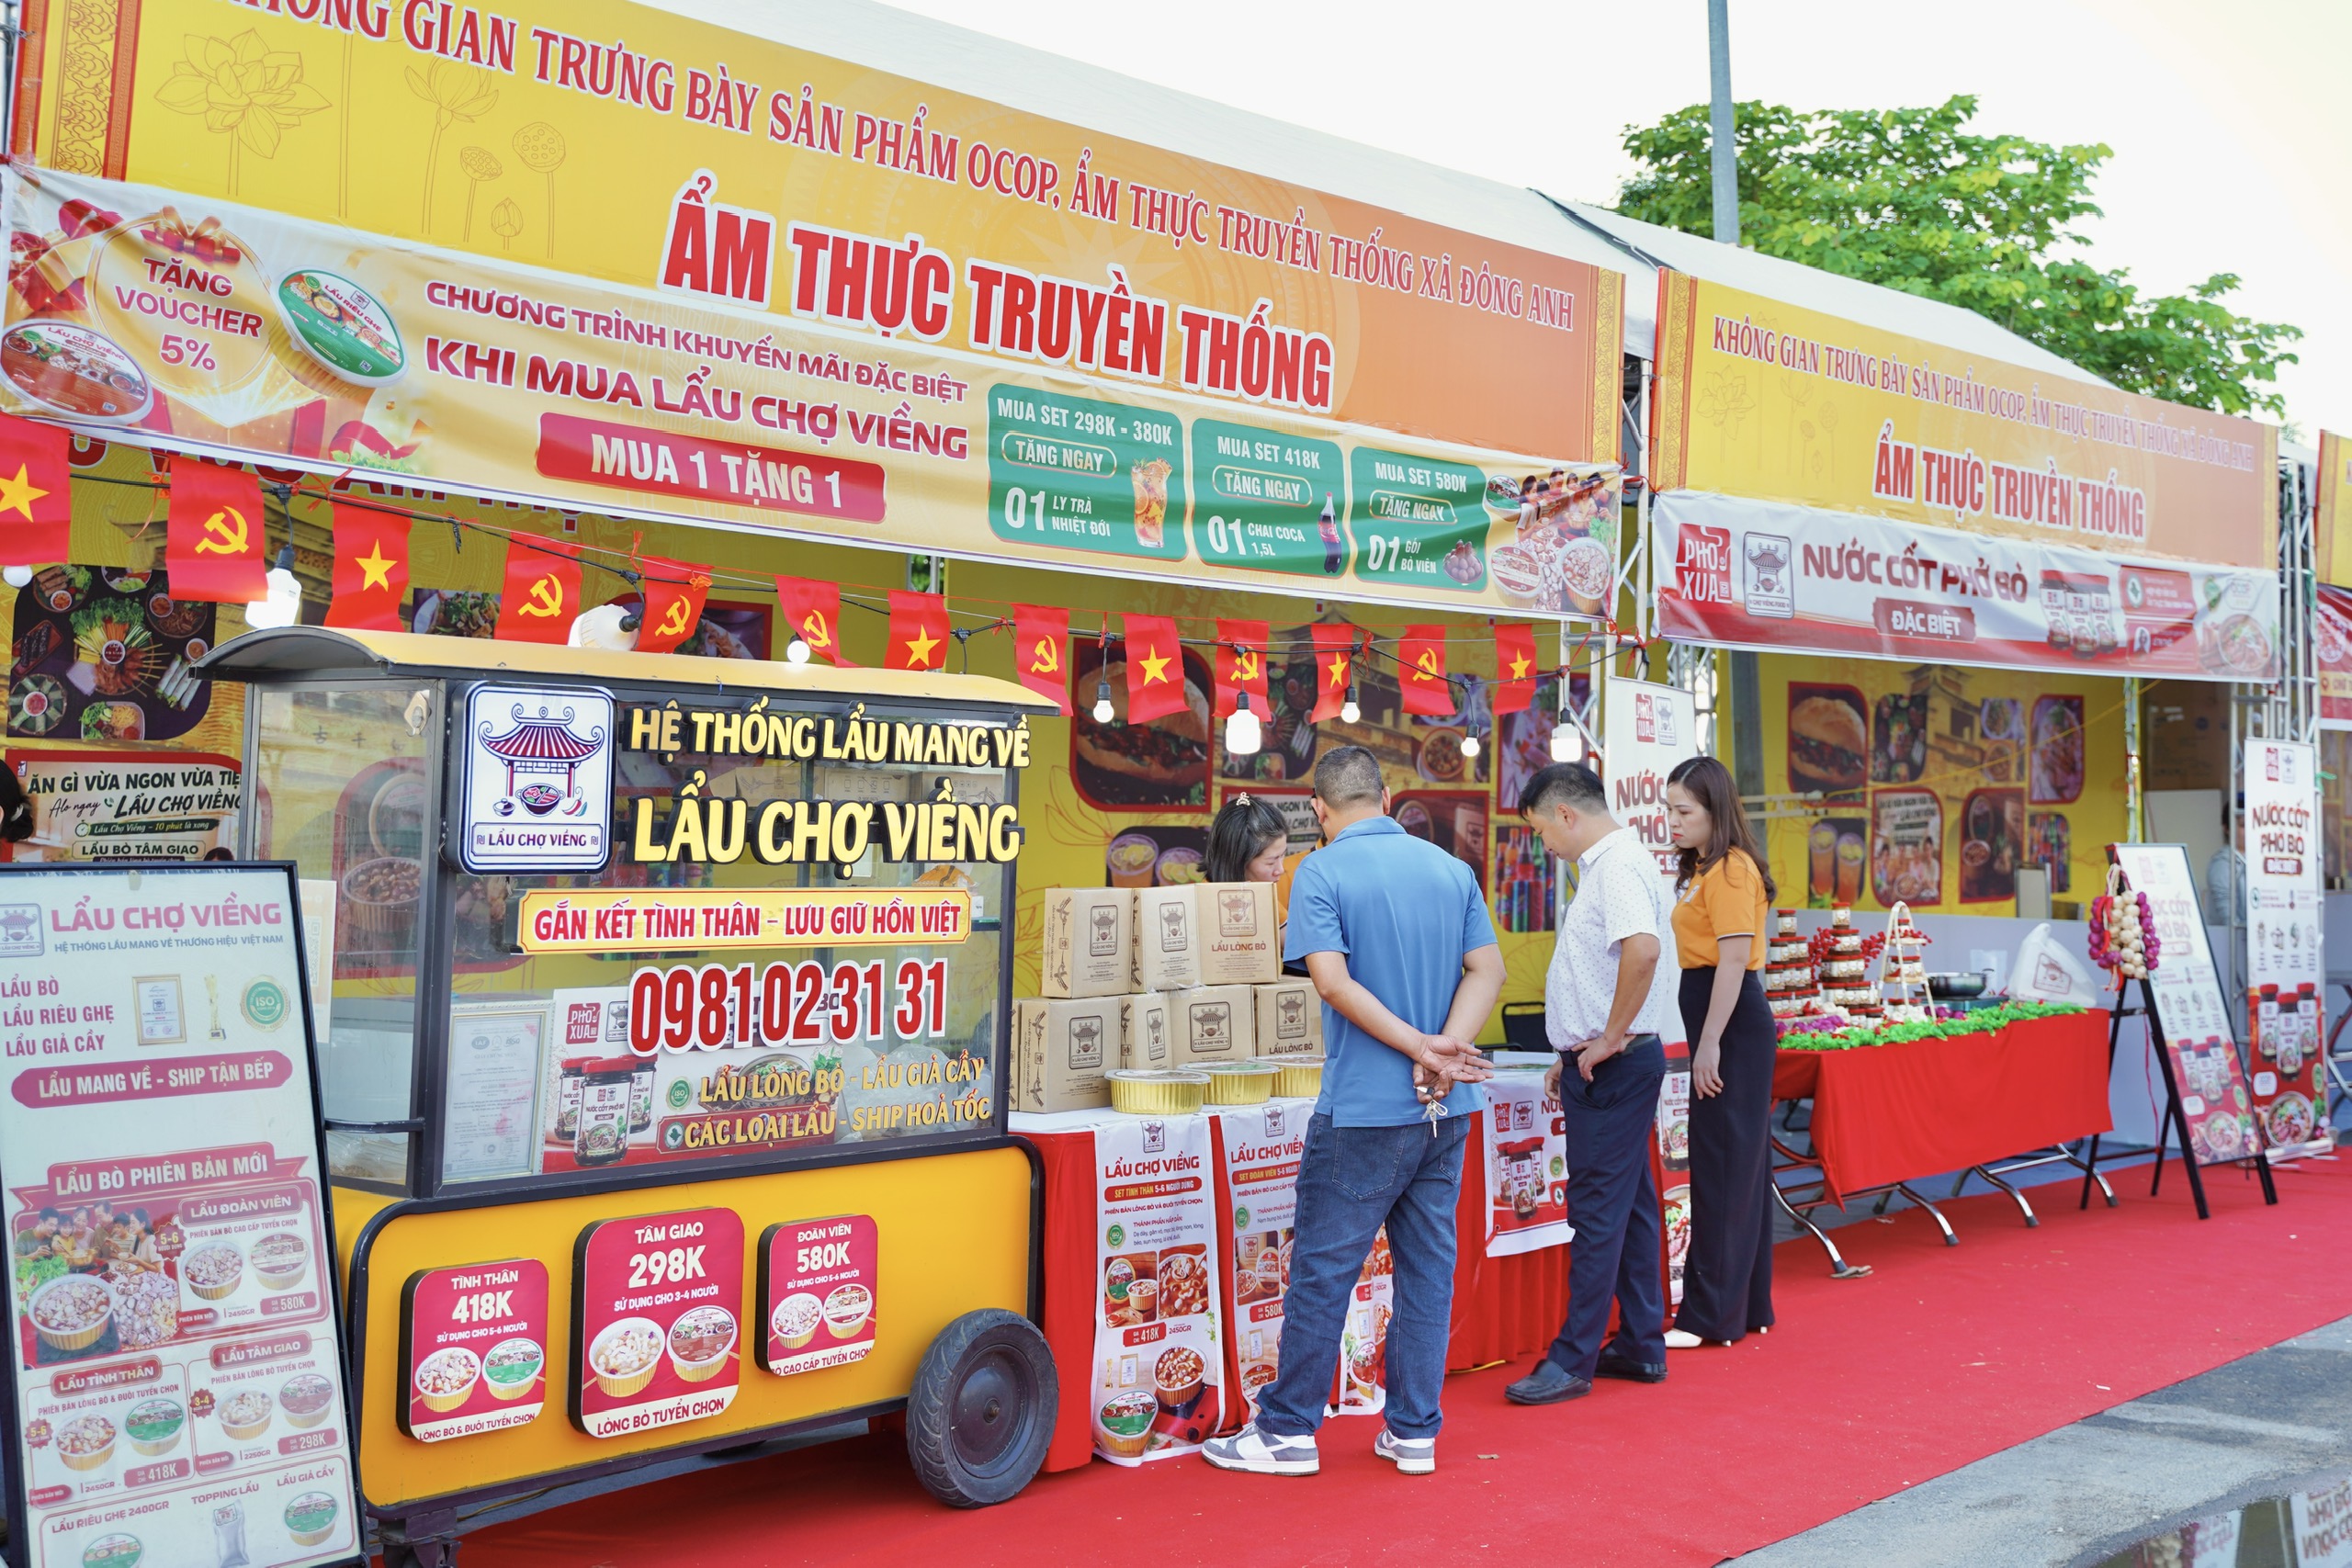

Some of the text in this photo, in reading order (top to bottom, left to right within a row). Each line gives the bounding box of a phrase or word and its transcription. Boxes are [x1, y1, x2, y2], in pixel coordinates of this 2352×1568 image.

[402, 0, 516, 73] GIAN
[531, 26, 674, 112] TRƯNG
[687, 65, 760, 131] BÀY
[769, 85, 842, 153] SẢN
[855, 104, 957, 181] PHẨM
[968, 143, 1059, 209] OCOP,
[1070, 149, 1120, 223] ẨM
[1129, 184, 1208, 248] THỰC
[1218, 209, 1319, 271] TRUYỀN
[1329, 230, 1413, 293] THỐNG
[1420, 258, 1453, 299] XÃ
[1458, 266, 1521, 317] ĐÔNG
[1529, 289, 1573, 330] ANH
[663, 175, 1331, 409] ẨM THỰC TRUYỀN THỐNG
[115, 286, 263, 337] VOUCHER
[160, 334, 216, 370] 5%
[426, 281, 967, 403] CHƯƠNG TRÌNH KHUYẾN MÃI ĐẶC BIỆT
[426, 338, 967, 459] KHI MUA LẨU CHỢ VIỀNG
[1713, 316, 1775, 363] KHÔNG
[1781, 336, 1819, 374] GIAN
[1826, 347, 1877, 387] TRƯNG
[1882, 355, 1908, 395] BÀY
[1912, 361, 1939, 401] SẢN
[1944, 367, 1985, 412] PHẨM
[2030, 384, 2050, 428] ẨM
[2054, 403, 2087, 441] THỰC
[2091, 405, 2137, 448] TRUYỀN
[2140, 412, 2178, 455] THỐNG
[998, 398, 1172, 446] MUA SET 298K 380K
[592, 434, 841, 507] MUA 1 TẶNG 1
[1375, 462, 1467, 492] MUA SET 580K
[1875, 423, 2143, 537] ẨM THỰC TRUYỀN THỐNG
[1052, 516, 1111, 536] NHIỆT ĐỚI
[1248, 523, 1306, 542] CHAI COCA
[1251, 543, 1275, 557] 1,5L
[1406, 538, 1420, 553] GÓI
[1401, 558, 1436, 573] BÒ VIÊN
[1803, 536, 2027, 604] NƯỚC CỐT PHỞ BÒ
[1892, 606, 1961, 639] ĐẶC BIỆT
[631, 694, 1030, 767] HỆ THỐNG LẨU MANG VỀ
[28, 773, 55, 794] ĂN
[61, 772, 78, 792] GÌ
[85, 771, 120, 790] VỪA
[126, 773, 175, 789] NGON
[181, 768, 214, 786] VỪA
[1616, 769, 1666, 810] NƯỚC
[489, 828, 514, 846] LẨU
[518, 834, 547, 849] CHỢ
[634, 769, 1021, 879] LẨU CHỢ VIỀNG
[83, 841, 199, 855] LẨU BÒ TÂM GIAO
[51, 892, 282, 933] LẨU CHỢ VIỀNG
[535, 897, 960, 941] GẮN KẾT TÌNH THÂN LƯU GIỮ HỒN VIỆT
[1212, 941, 1266, 952] LẨU LÒNG BÒ
[255, 997, 275, 1006] ISO
[39, 1056, 273, 1099] LẨU MANG VỀ SHIP TẬN BẾP
[1105, 1151, 1199, 1179] LẨU CHỢ VIỀNG
[1114, 1189, 1125, 1198] SET
[1126, 1185, 1138, 1196] TÌNH
[1155, 1183, 1165, 1192] 5-6
[635, 1222, 704, 1244] TÂM GIAO
[829, 1224, 851, 1237] VIÊN
[628, 1246, 706, 1289] 298K
[797, 1241, 851, 1273] 580K
[451, 1269, 518, 1290] TÌNH THÂN
[280, 1295, 305, 1312] 580K
[452, 1290, 514, 1324] 418K
[614, 1284, 718, 1312] SỬ DỤNG CHO 3-4 NGƯỜI
[1141, 1325, 1159, 1342] 418K
[598, 1397, 724, 1435] LÒNG BÒ TUYỂN CHỌN
[300, 1434, 326, 1449] 298K
[148, 1464, 176, 1481] 418K
